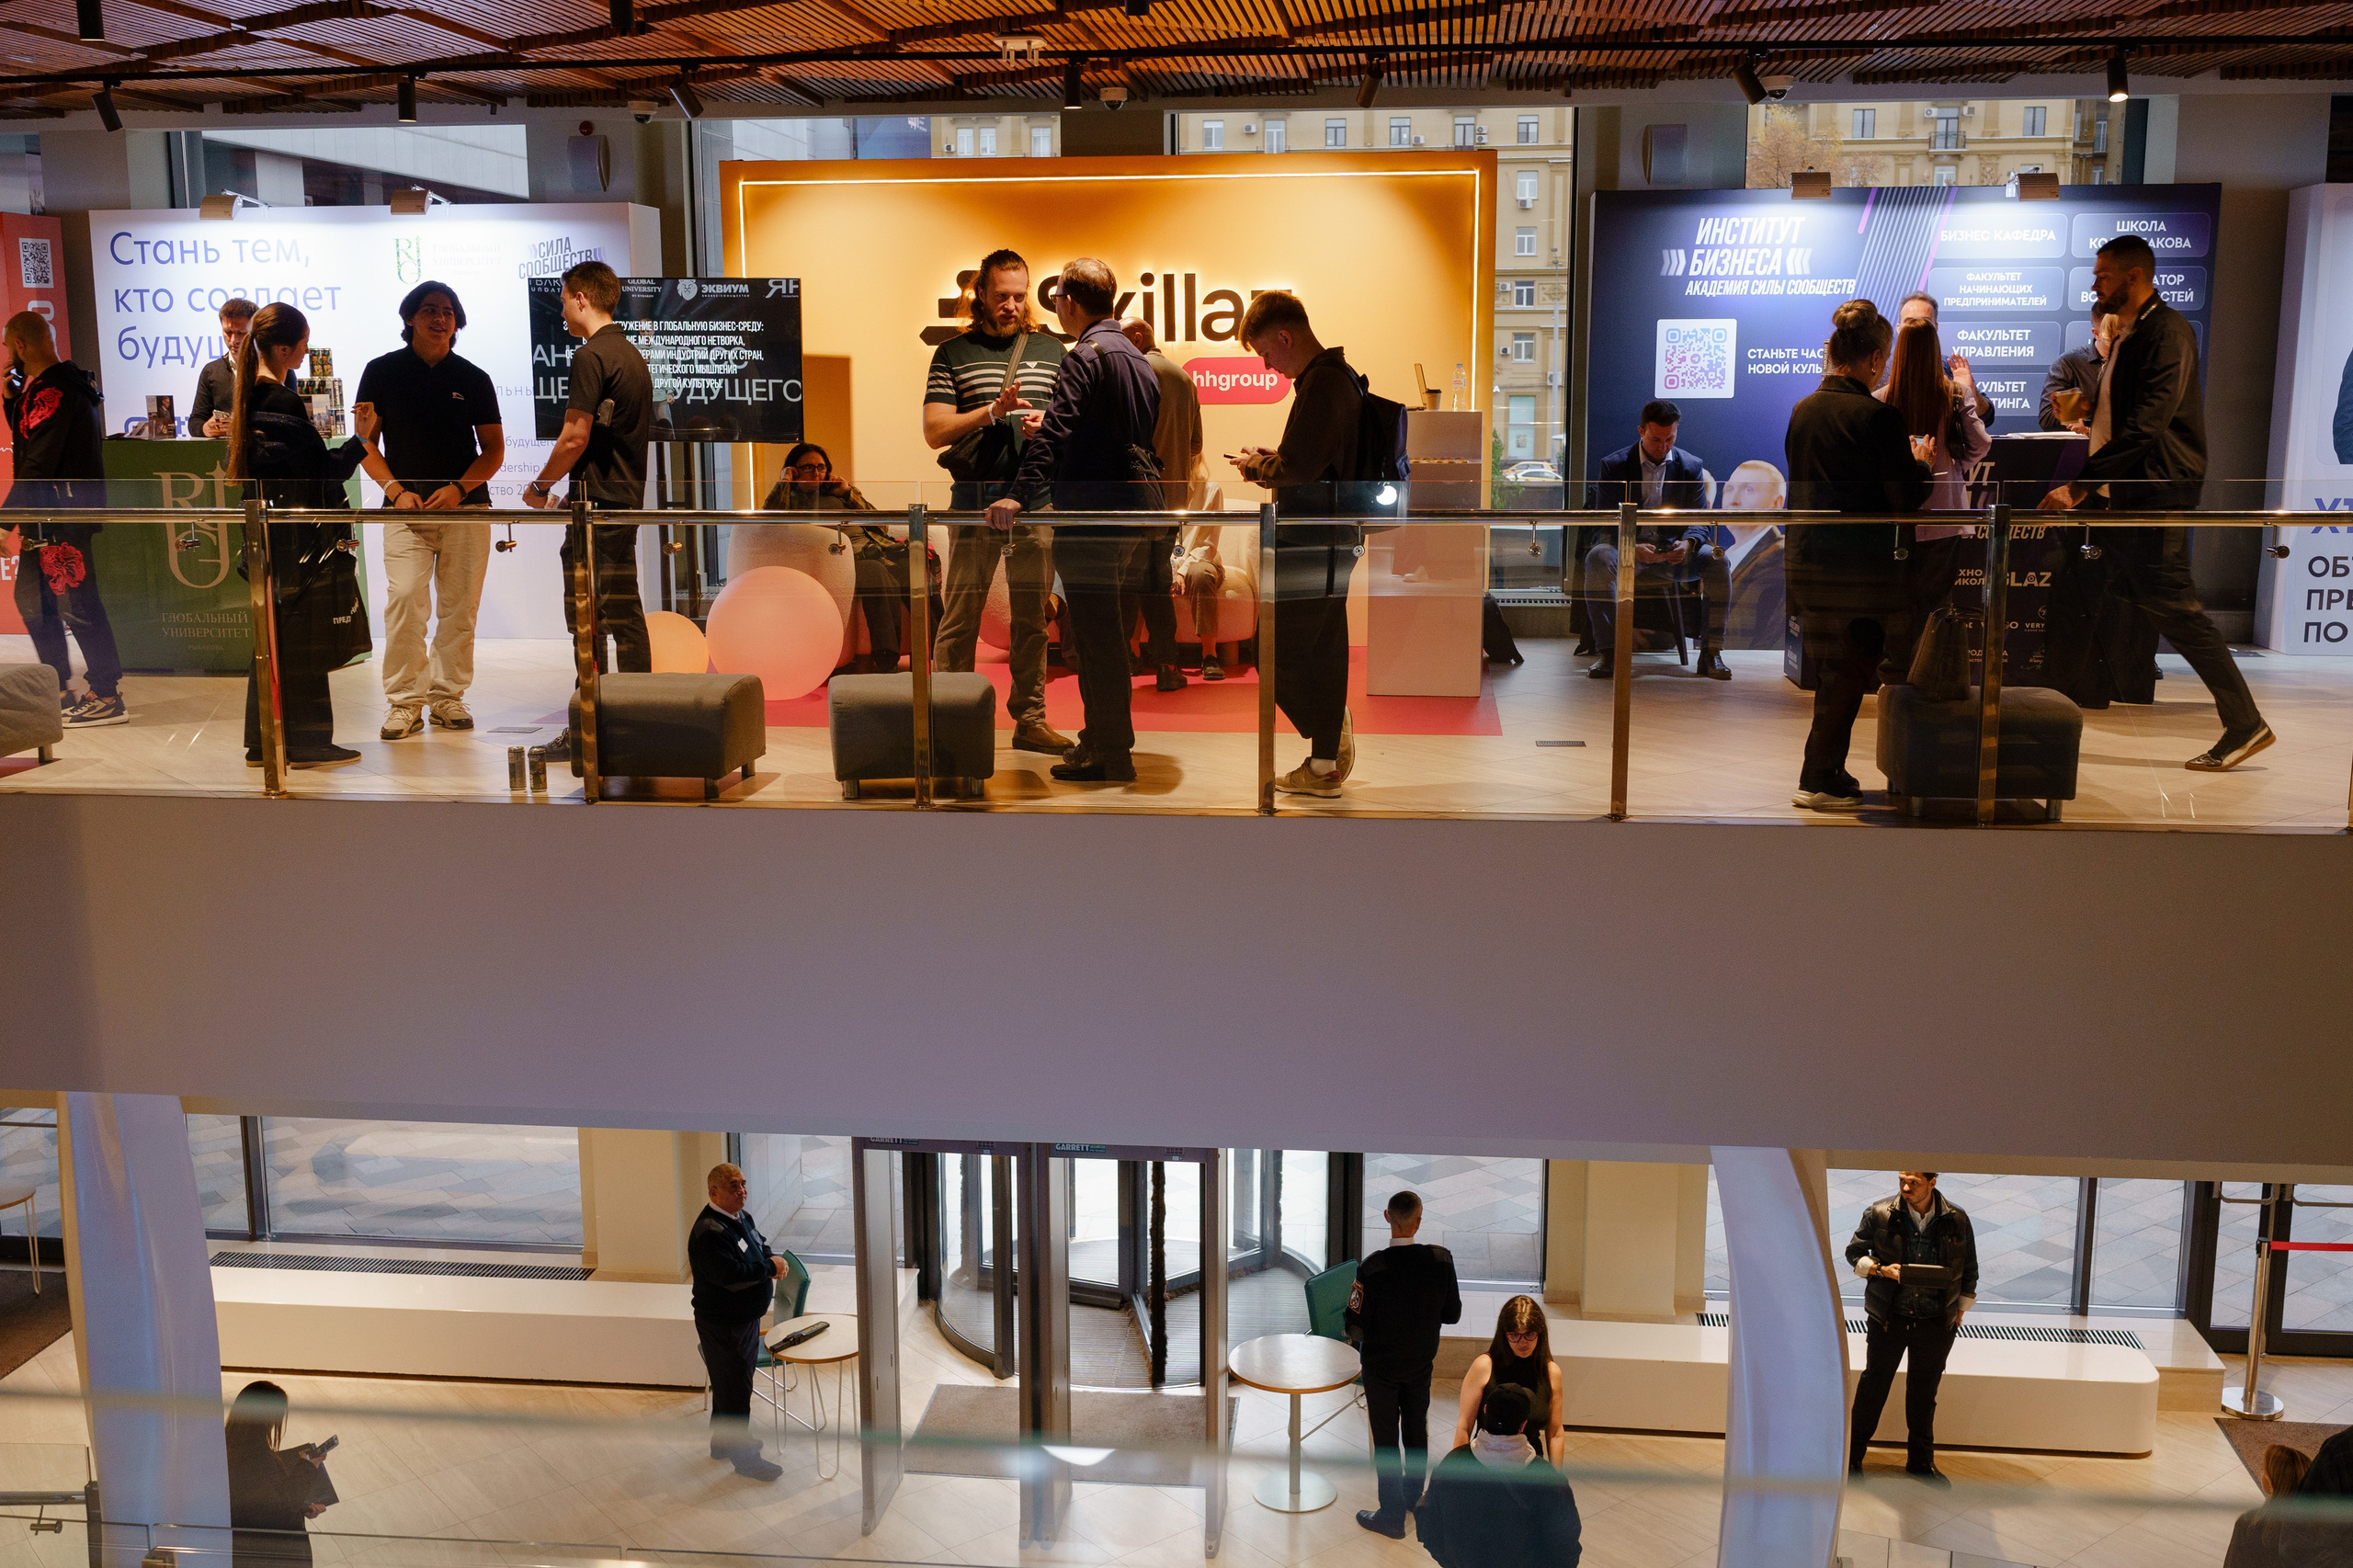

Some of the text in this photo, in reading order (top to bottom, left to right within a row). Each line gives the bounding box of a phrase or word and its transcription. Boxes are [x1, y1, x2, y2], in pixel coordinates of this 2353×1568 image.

[1695, 216, 1804, 245] ИНСТИТУТ
[2116, 221, 2167, 232] ШКОЛА
[1940, 229, 2056, 243] БИЗНЕС КАФЕДРА
[109, 231, 310, 267] Стань тем,
[539, 236, 572, 258] СИЛА
[518, 249, 594, 279] СООБЩЕСТВ
[1688, 247, 1783, 277] БИЗНЕСА
[1965, 272, 2022, 281] ФАКУЛЬТЕТ
[701, 283, 749, 293] ЭКВИУМ
[1685, 278, 1857, 297] АКАДЕМИЯ СИЛЫ СООБЩЕСТВ
[1959, 284, 2033, 295] НАЧИНАЮЩИХ
[114, 288, 174, 312] кто
[1943, 294, 2047, 307] ПРЕДПРИНИМАТЕЛЕЙ
[1038, 272, 1292, 344] Silla
[654, 321, 659, 331] В
[659, 321, 709, 331] ГЛОБАЛЬНУЮ
[709, 321, 764, 332] БИЗНЕС-СРЕДУ:
[638, 335, 706, 347] МЕЖДУНАРОДНОГО
[707, 335, 745, 347] НЕТВОРКА,
[1957, 329, 2031, 341] ФАКУЛЬТЕТ
[666, 348, 709, 360] ИНДУСТРИЙ
[710, 350, 738, 361] ДРУГИХ
[739, 350, 765, 361] СТРАН,
[1747, 348, 1824, 359] СТАНЬТЕ ЧАС
[1951, 346, 2034, 358] УПРАВЛЕНИЯ
[647, 364, 738, 374] ТЕГИЧЕСКОГО МЫШЛЕНИЯ
[1747, 361, 1823, 374] НОВОЙ КУЛЬ
[654, 378, 682, 389] ДРУГОЙ
[1193, 370, 1279, 391] hhgroup
[1976, 381, 2027, 392] КУЛЬТЕТ
[1993, 398, 2030, 409] ТИНГА
[499, 462, 540, 475] dership
[2308, 556, 2353, 577] ОБ
[161, 611, 249, 623] ГЛОБАЛЬНЫЙ
[161, 628, 252, 638] УНИВЕРСИТЕТ
[2303, 622, 2348, 642] ПО
[1055, 1142, 1090, 1152] GARRETT
